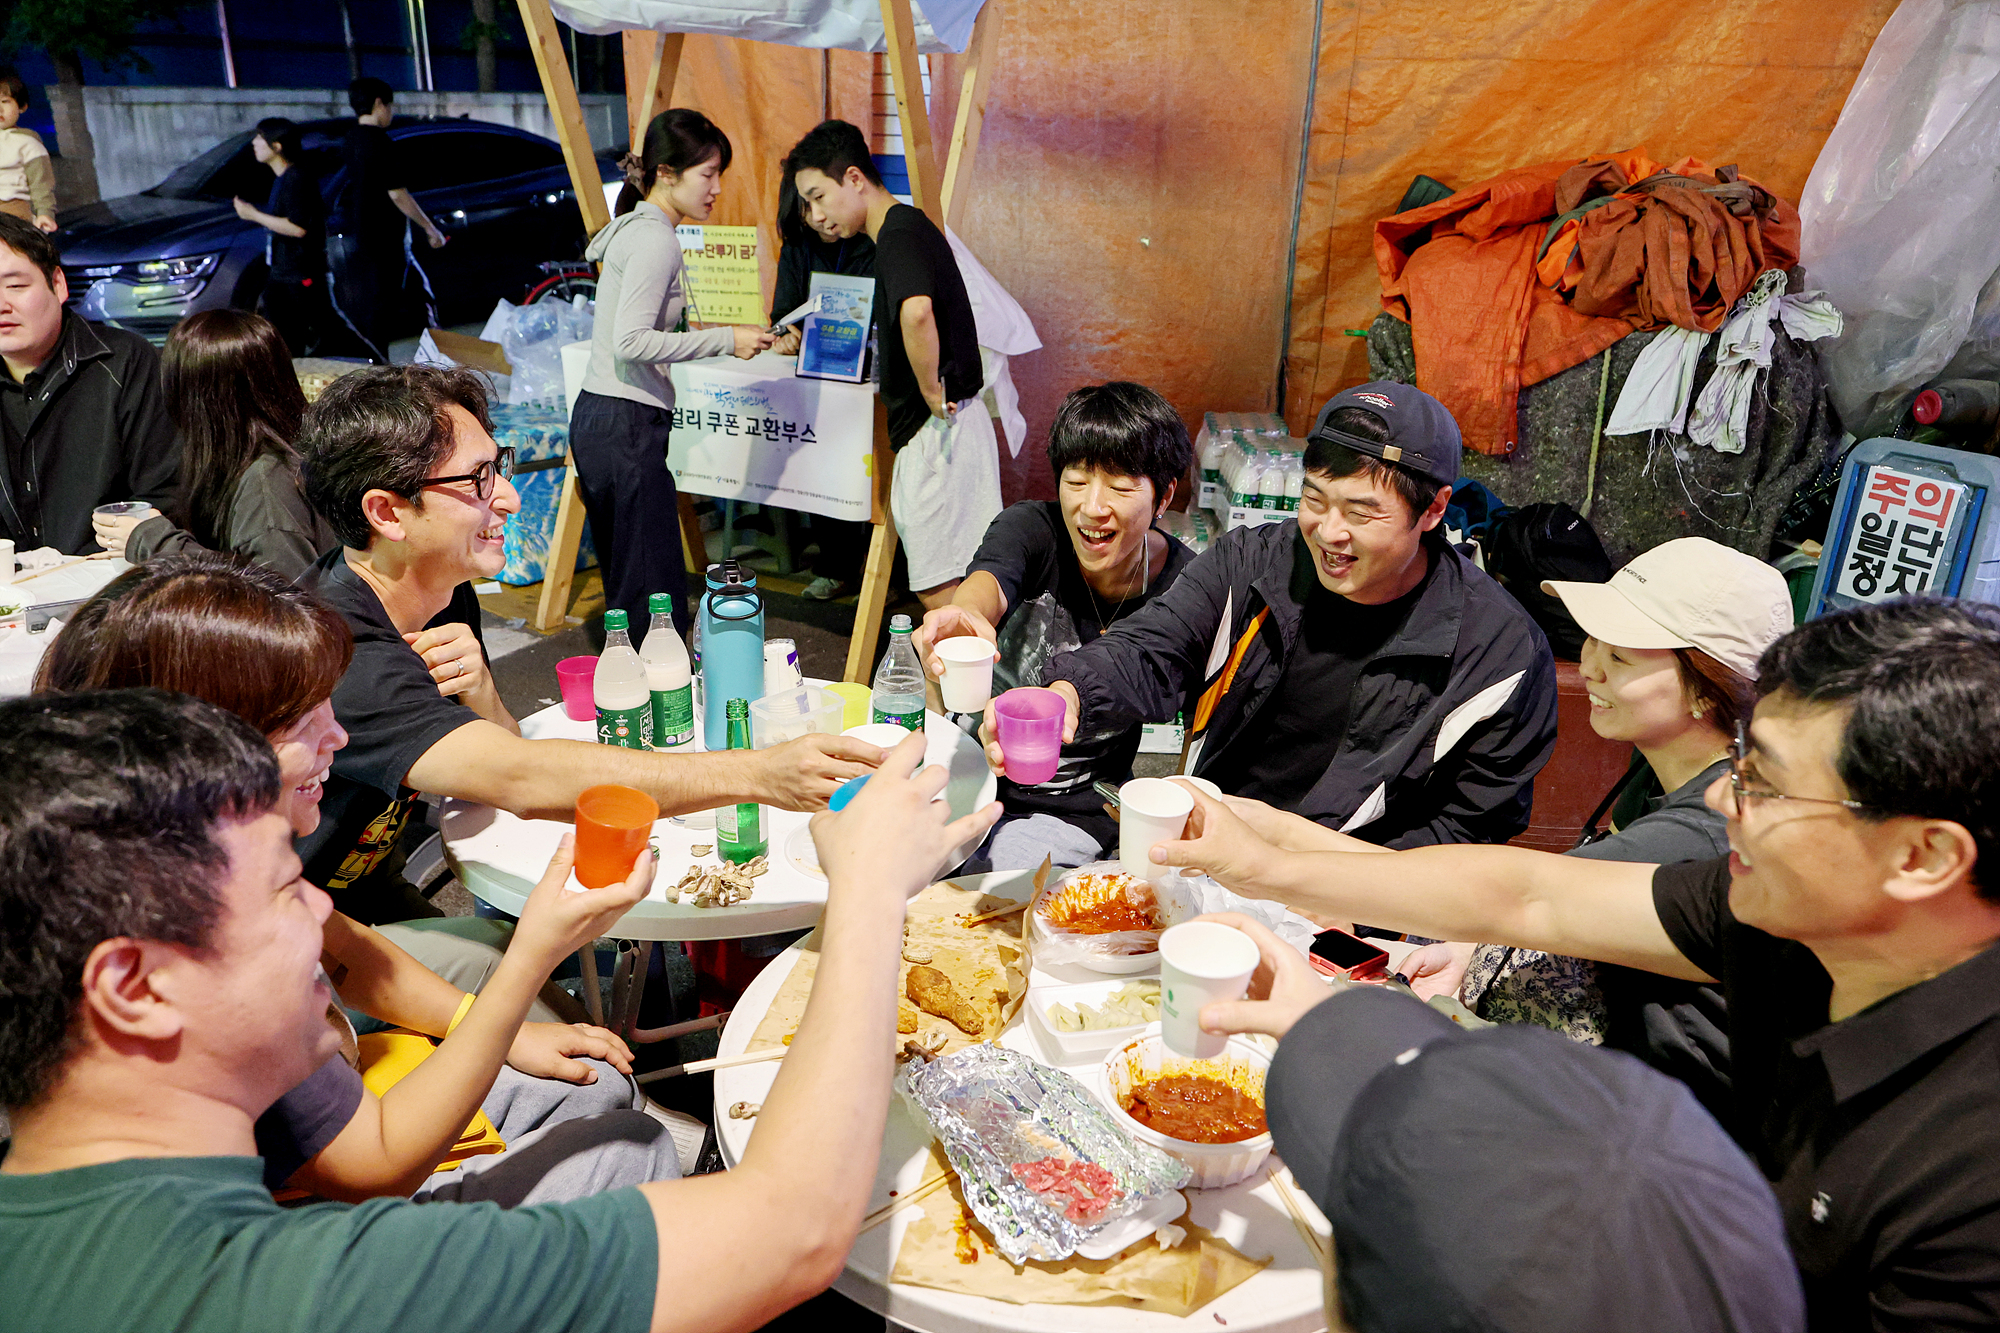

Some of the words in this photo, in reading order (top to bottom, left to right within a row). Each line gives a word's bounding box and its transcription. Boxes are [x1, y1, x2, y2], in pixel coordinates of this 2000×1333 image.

[706, 411, 740, 436] 쿠폰
[745, 417, 817, 443] 교환부스
[1868, 472, 1956, 529] 주의
[1857, 512, 1944, 570] 일단
[1849, 552, 1930, 597] 정지
